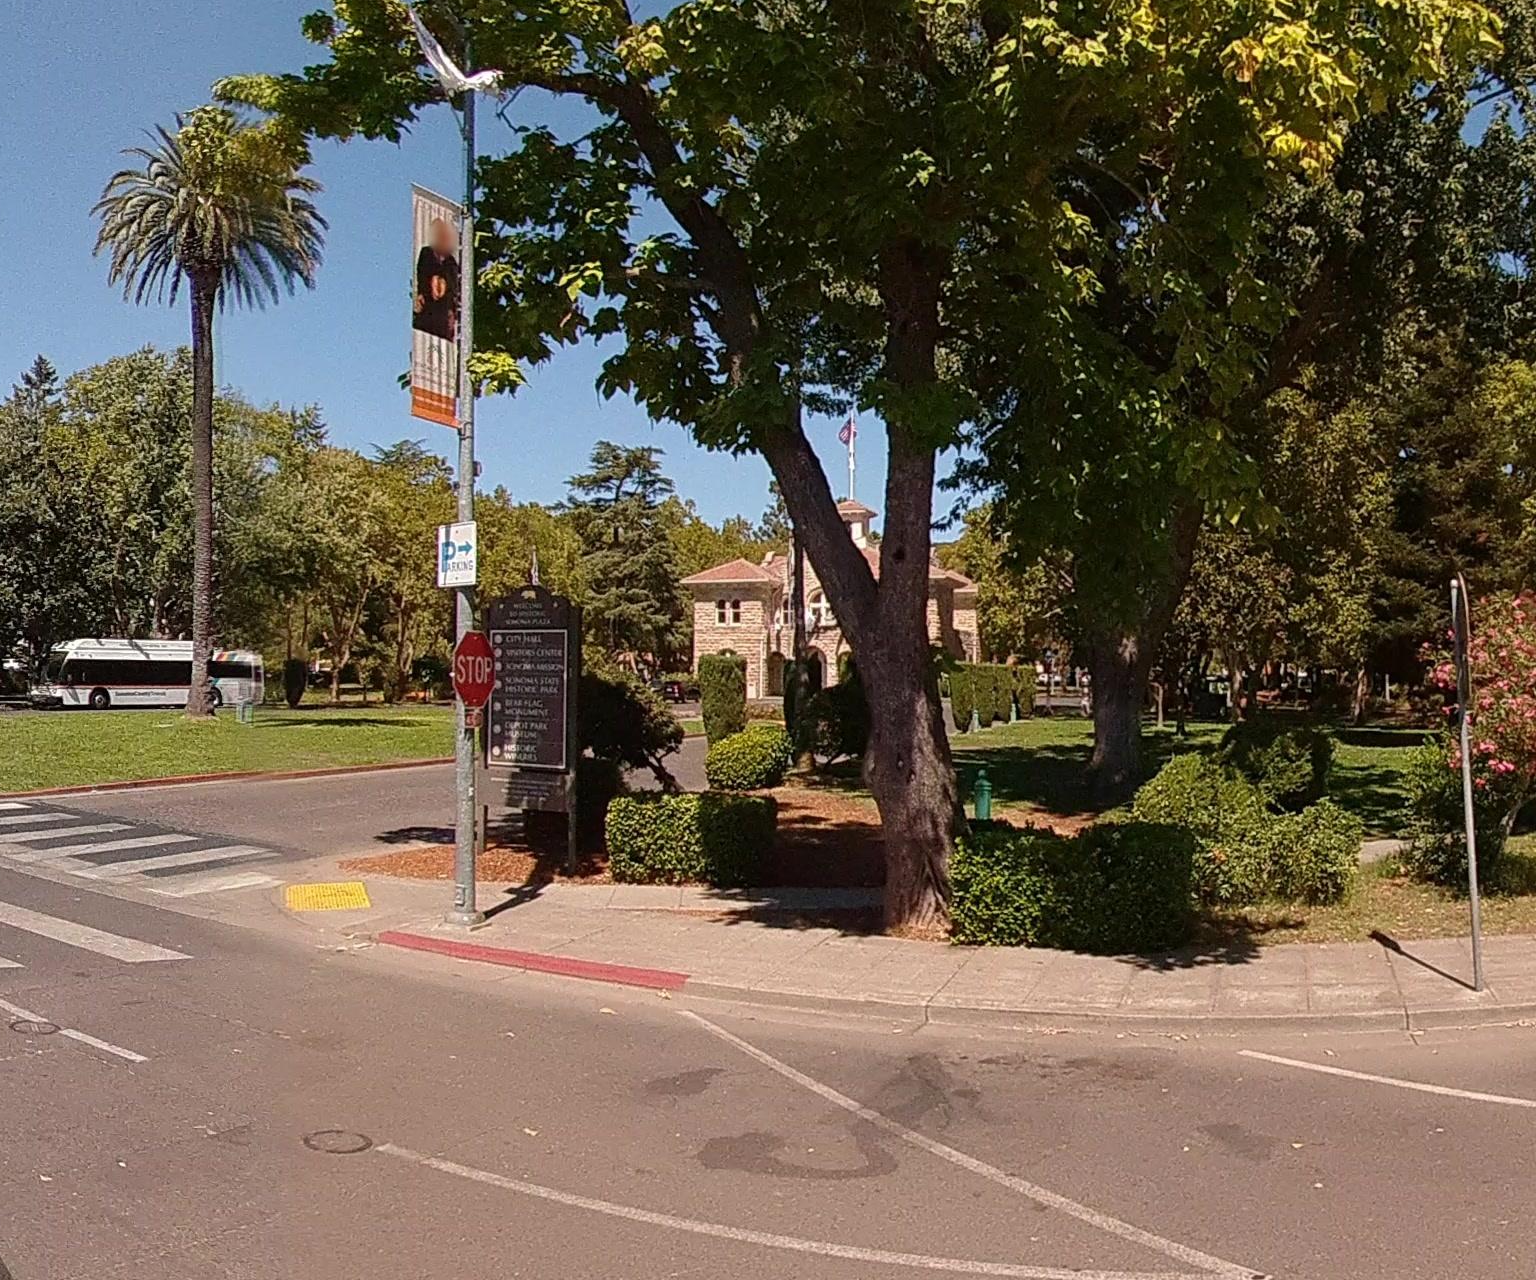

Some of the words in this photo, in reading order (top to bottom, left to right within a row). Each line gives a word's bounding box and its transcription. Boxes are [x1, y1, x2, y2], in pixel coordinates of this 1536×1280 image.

[505, 649, 535, 657] VISITORS
[536, 649, 563, 657] CENTER
[456, 655, 493, 684] STOP
[504, 699, 523, 707] BEAR
[504, 721, 528, 729] DEPOT
[530, 722, 548, 730] PARK
[504, 730, 537, 738] MUSEUM
[503, 744, 537, 752] HISTORIC
[503, 752, 538, 760] WINERIES
